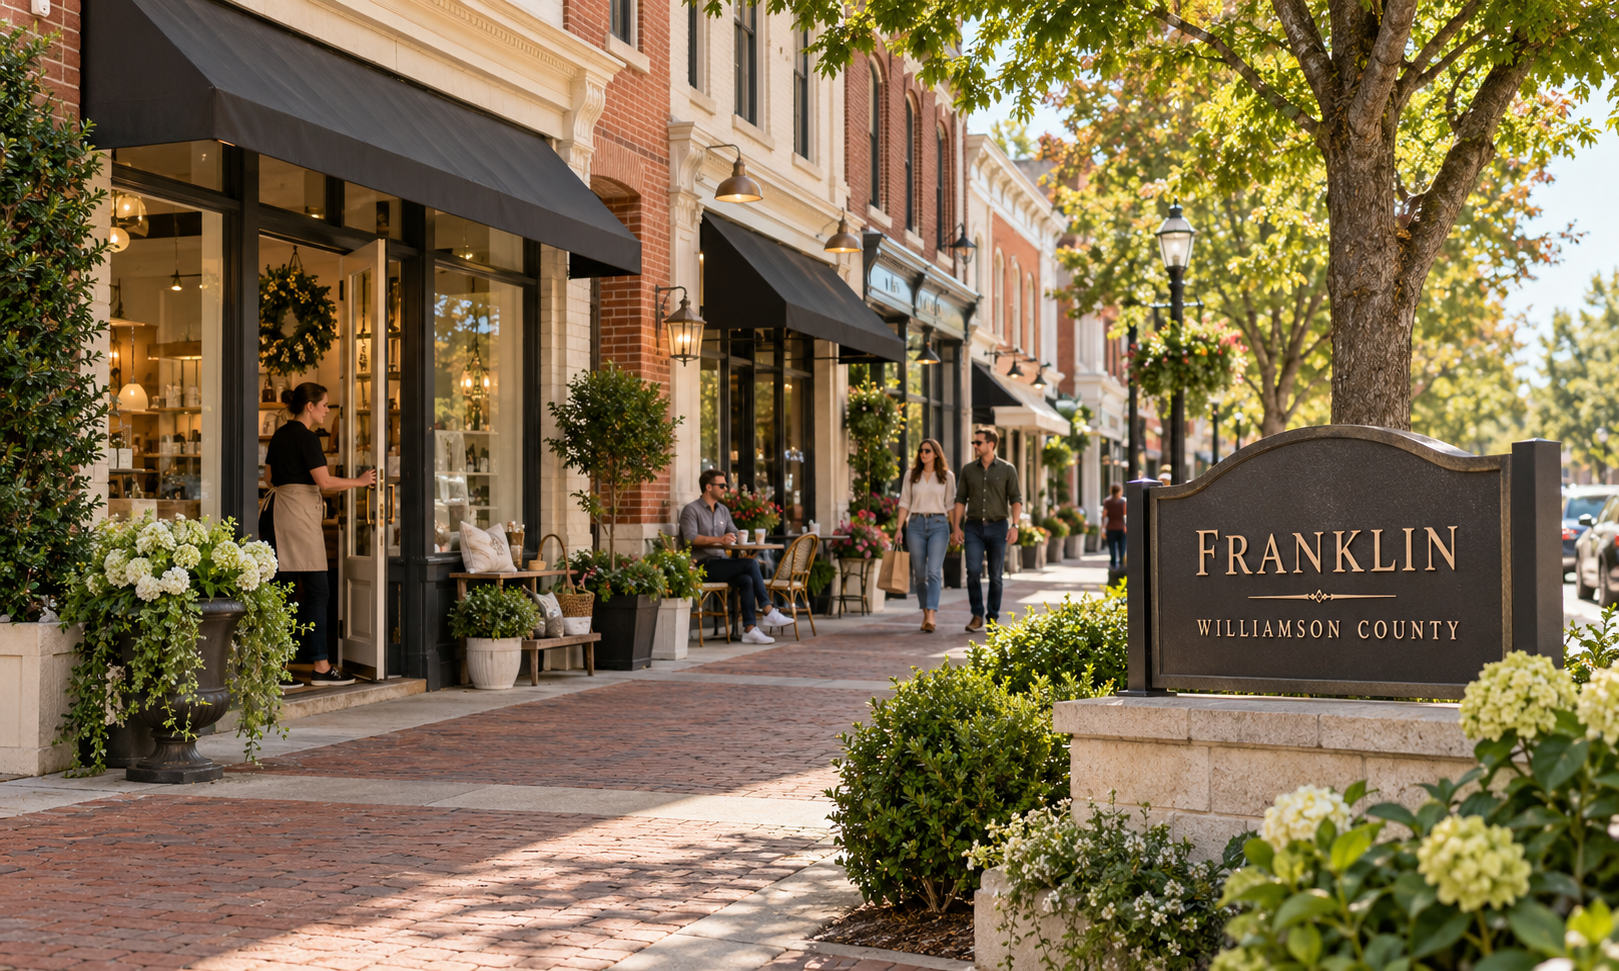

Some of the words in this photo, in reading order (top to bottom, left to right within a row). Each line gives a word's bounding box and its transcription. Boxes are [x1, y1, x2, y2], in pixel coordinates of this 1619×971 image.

[1196, 526, 1458, 576] FRANKLIN
[1197, 619, 1341, 638] WILLIAMSON
[1357, 620, 1460, 640] COUNTY
